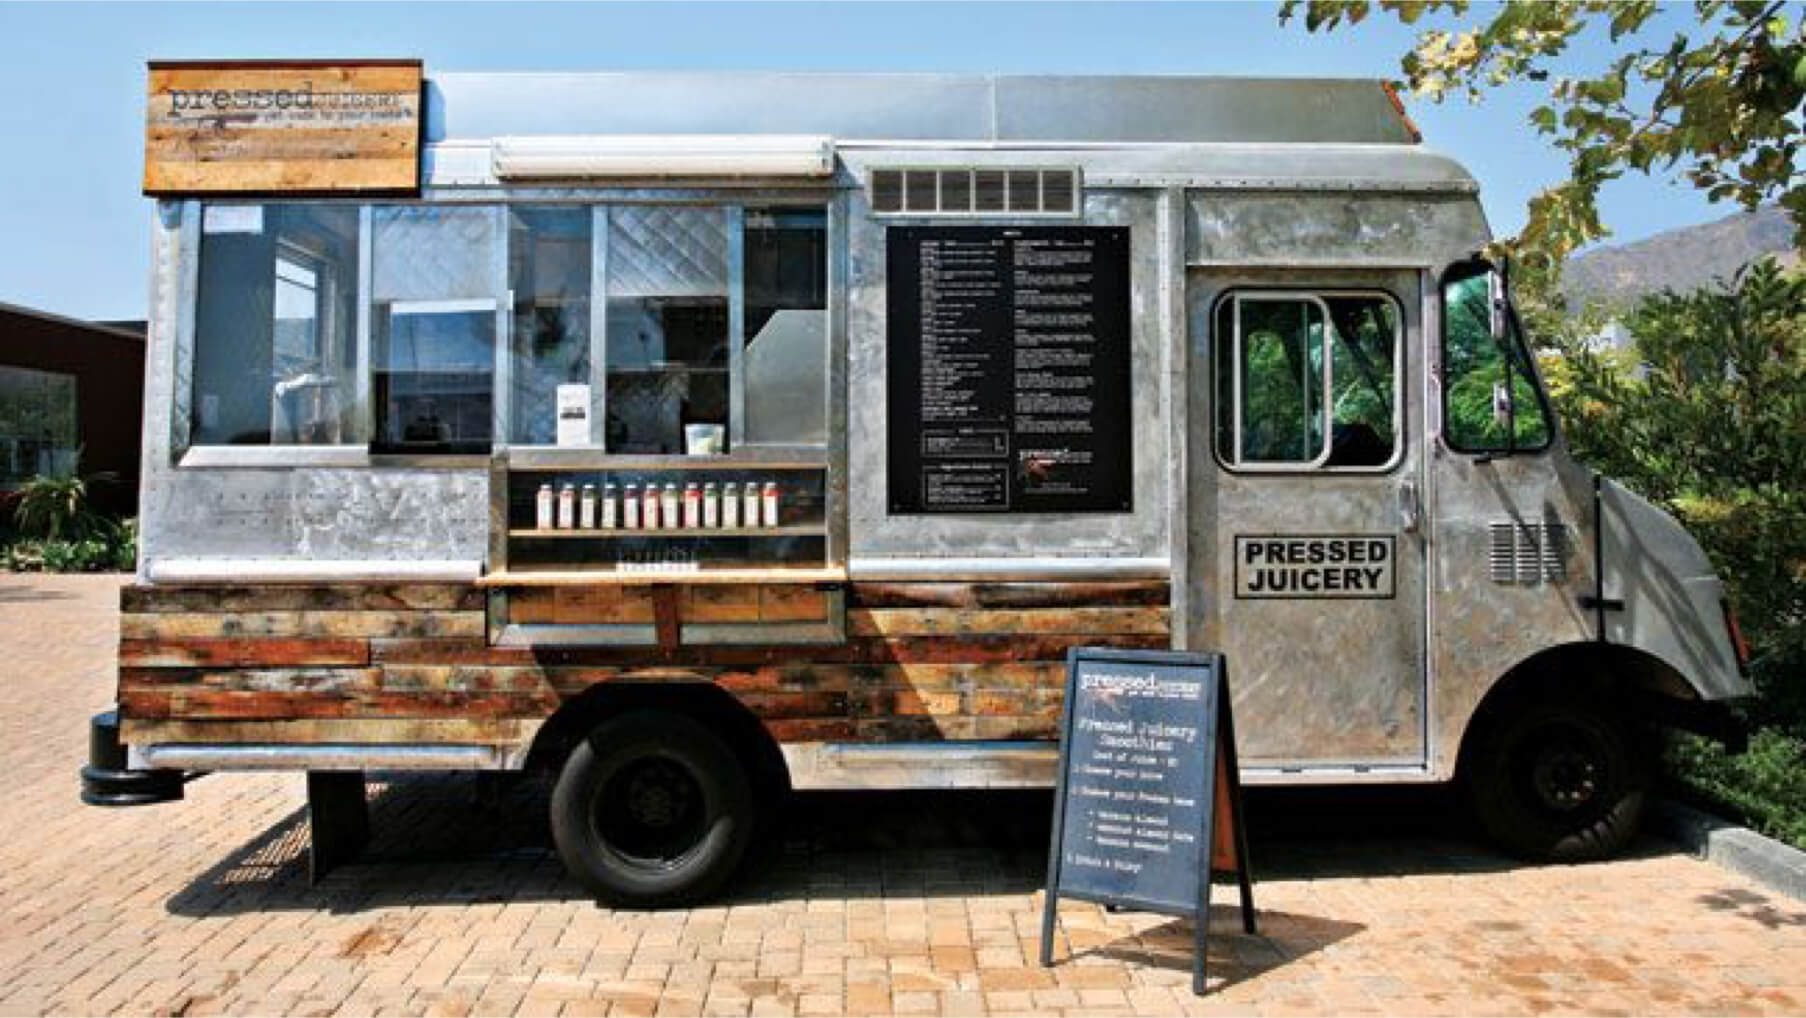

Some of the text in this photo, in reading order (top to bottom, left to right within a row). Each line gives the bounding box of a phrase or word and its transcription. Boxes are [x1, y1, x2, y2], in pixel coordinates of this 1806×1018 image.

[168, 81, 312, 117] pressed
[1246, 540, 1386, 564] PRESSED
[1248, 569, 1383, 591] JUICERY
